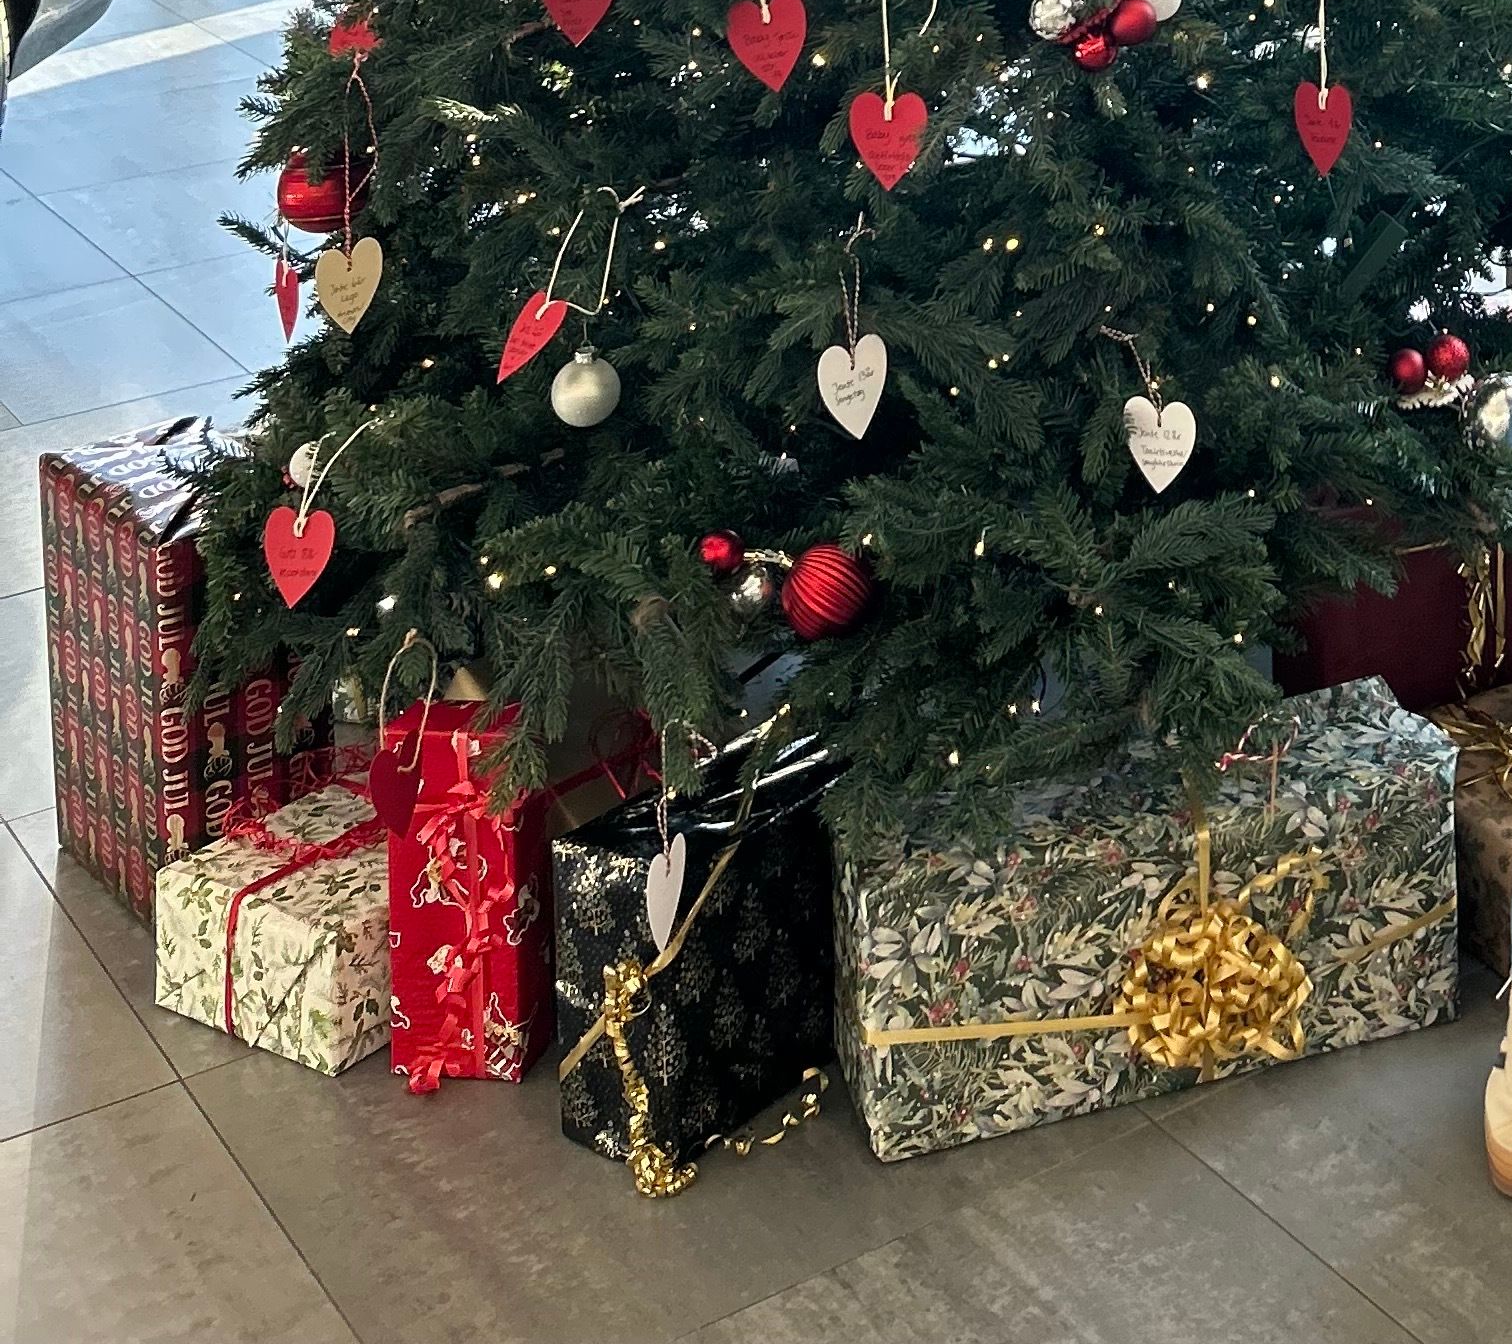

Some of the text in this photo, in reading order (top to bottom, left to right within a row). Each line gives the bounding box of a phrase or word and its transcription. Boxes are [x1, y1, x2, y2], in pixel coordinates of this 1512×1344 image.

[157, 602, 185, 652] JUL
[161, 706, 190, 816] GOD JUL
[245, 678, 274, 788] GOD JUL
